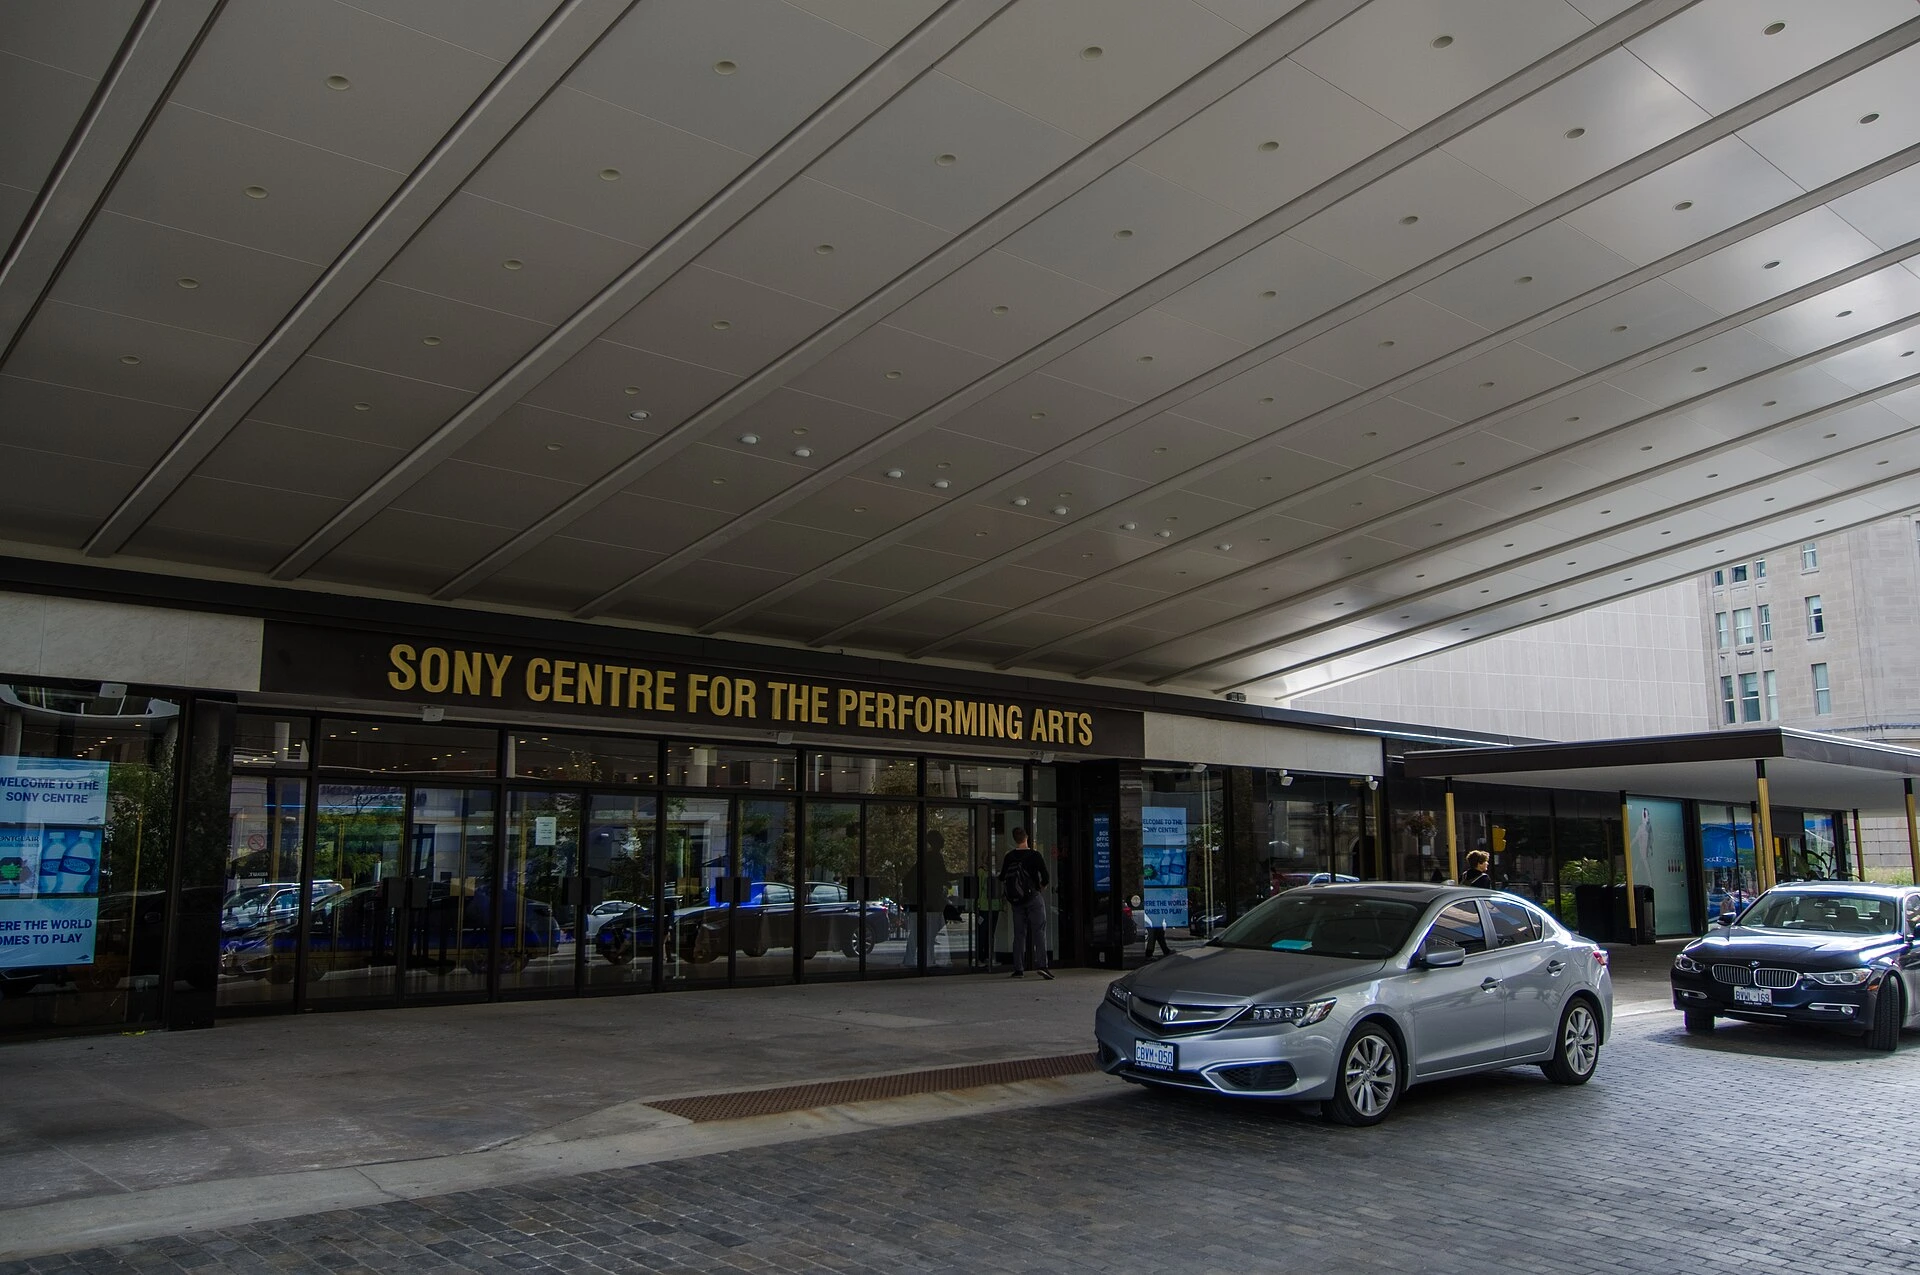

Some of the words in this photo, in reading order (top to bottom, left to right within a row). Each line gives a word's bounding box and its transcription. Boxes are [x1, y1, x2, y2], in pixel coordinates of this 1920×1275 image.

[387, 643, 513, 698] SONY
[526, 657, 677, 712] CENTRE
[687, 673, 757, 719] FOR
[767, 681, 829, 725] THE
[838, 688, 1023, 740] PERFORMING
[1031, 708, 1094, 747] ARTS
[60, 779, 74, 790] TO
[78, 780, 100, 791] THE
[5, 791, 40, 802] SONY
[42, 793, 89, 804] CENTRE
[1172, 818, 1183, 826] THE
[24, 920, 48, 931] THE
[50, 918, 93, 929] WORLD
[33, 934, 49, 945] TO
[52, 932, 83, 944] PLAY
